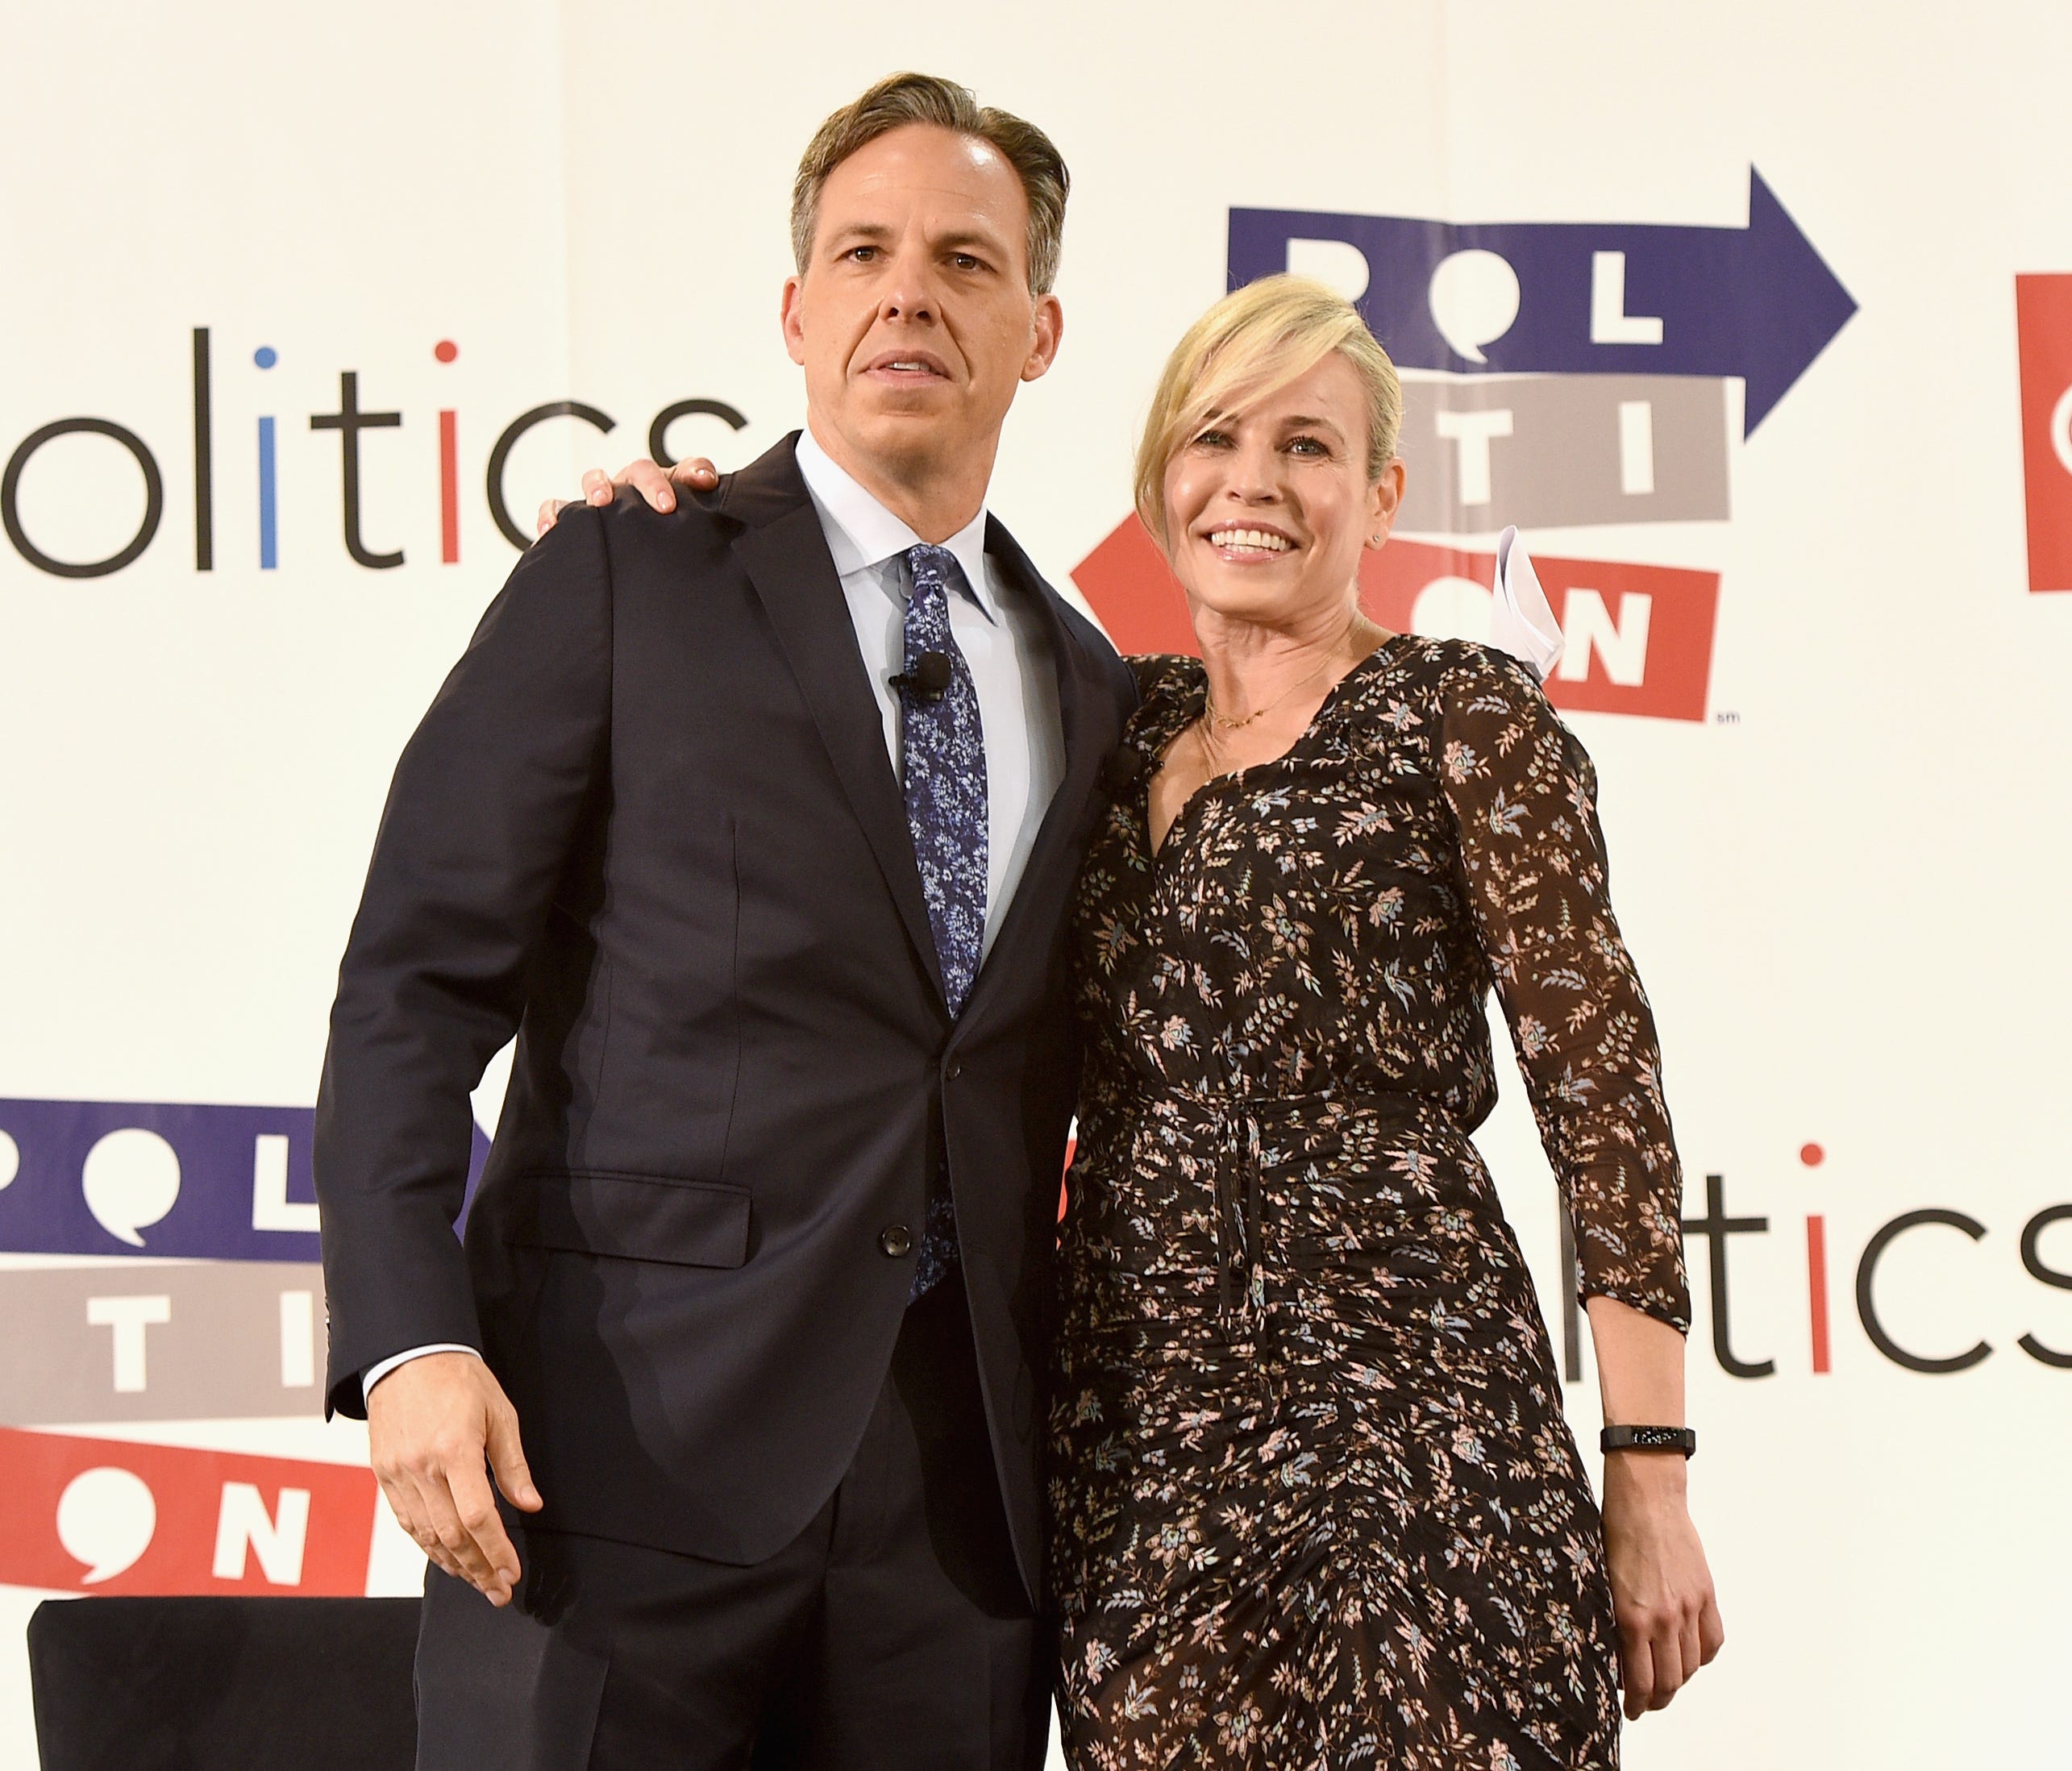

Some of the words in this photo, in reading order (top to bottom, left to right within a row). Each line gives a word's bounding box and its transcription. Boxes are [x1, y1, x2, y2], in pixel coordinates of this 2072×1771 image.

[0, 1127, 320, 1247] OL
[1559, 1142, 2072, 1382] ltics
[87, 1290, 314, 1393] TI
[56, 1465, 311, 1586] ON
